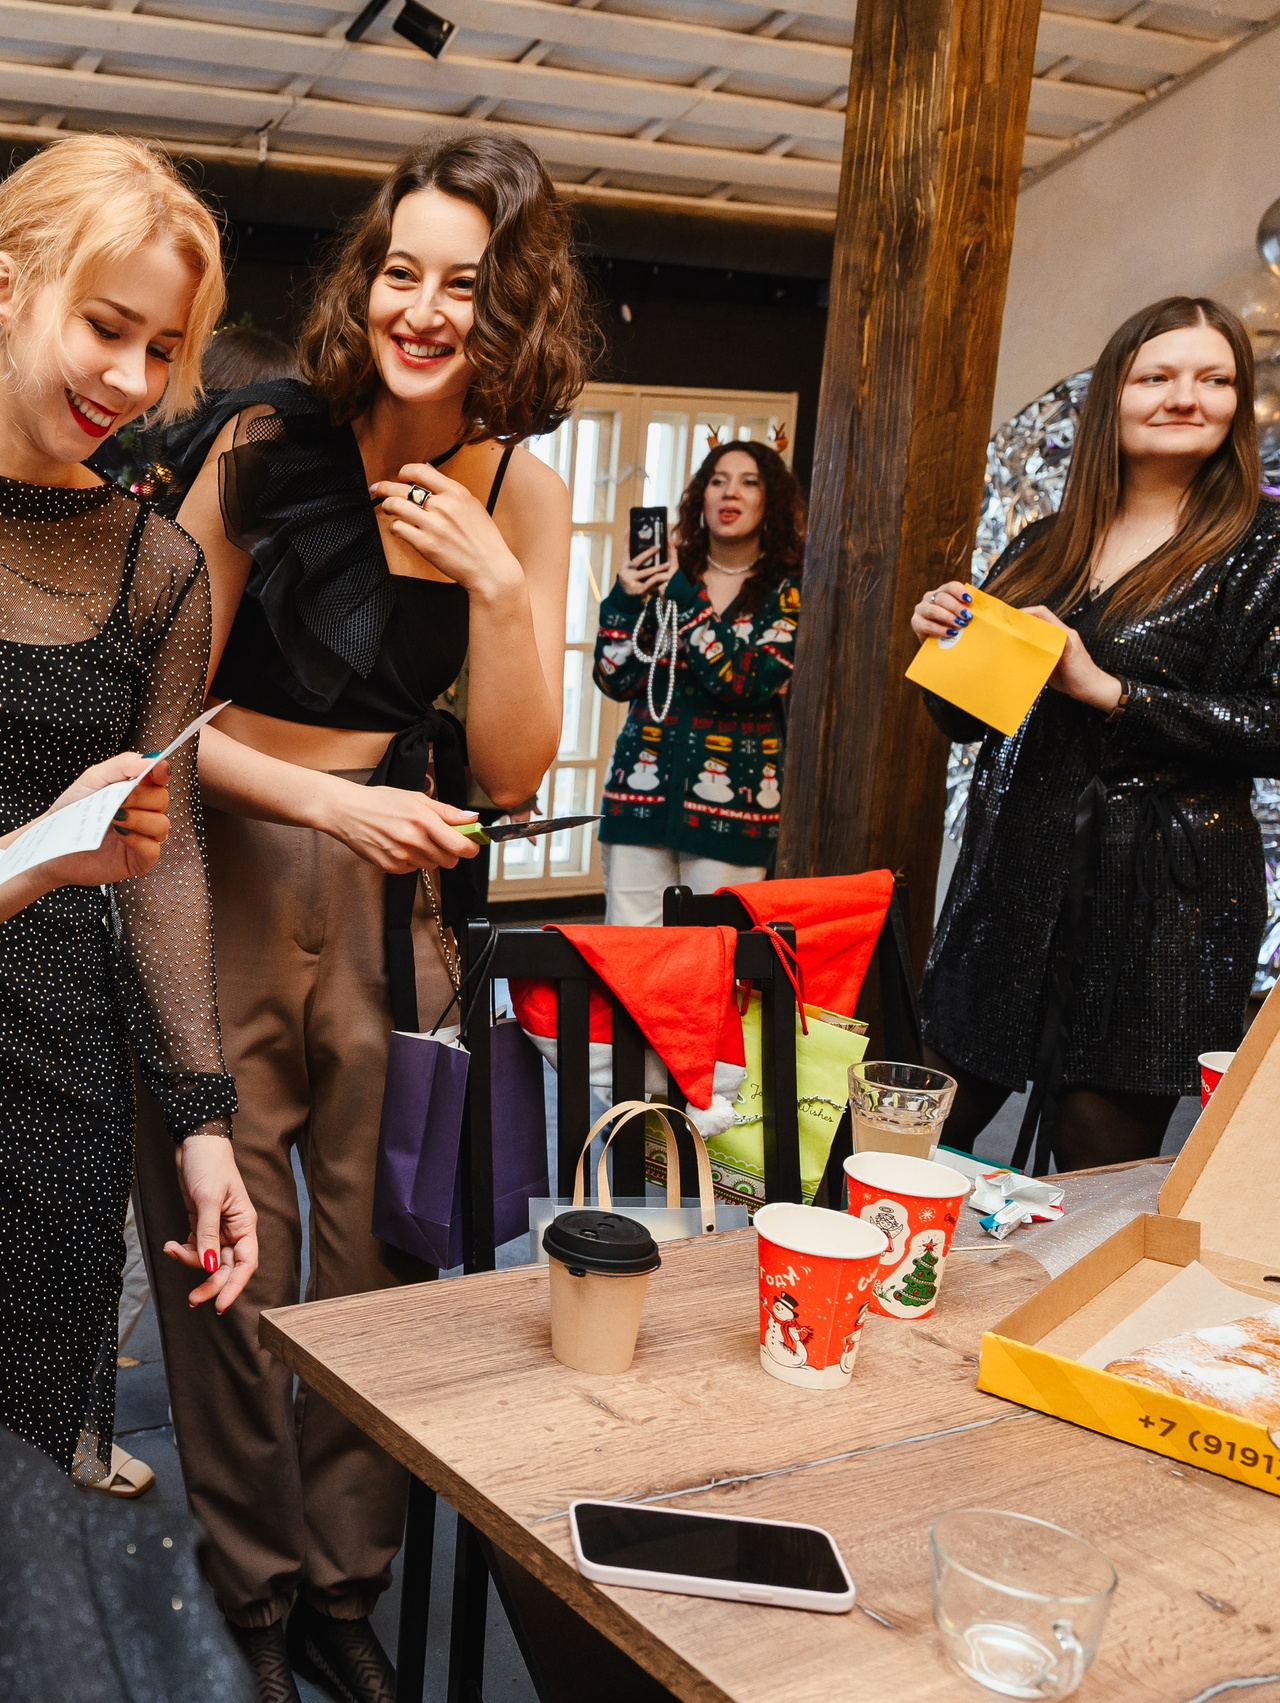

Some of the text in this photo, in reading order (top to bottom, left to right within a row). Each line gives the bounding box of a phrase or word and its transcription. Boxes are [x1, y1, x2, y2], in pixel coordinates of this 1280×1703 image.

[798, 1102, 834, 1123] Wishes
[1138, 1415, 1280, 1480] +7 (9191
